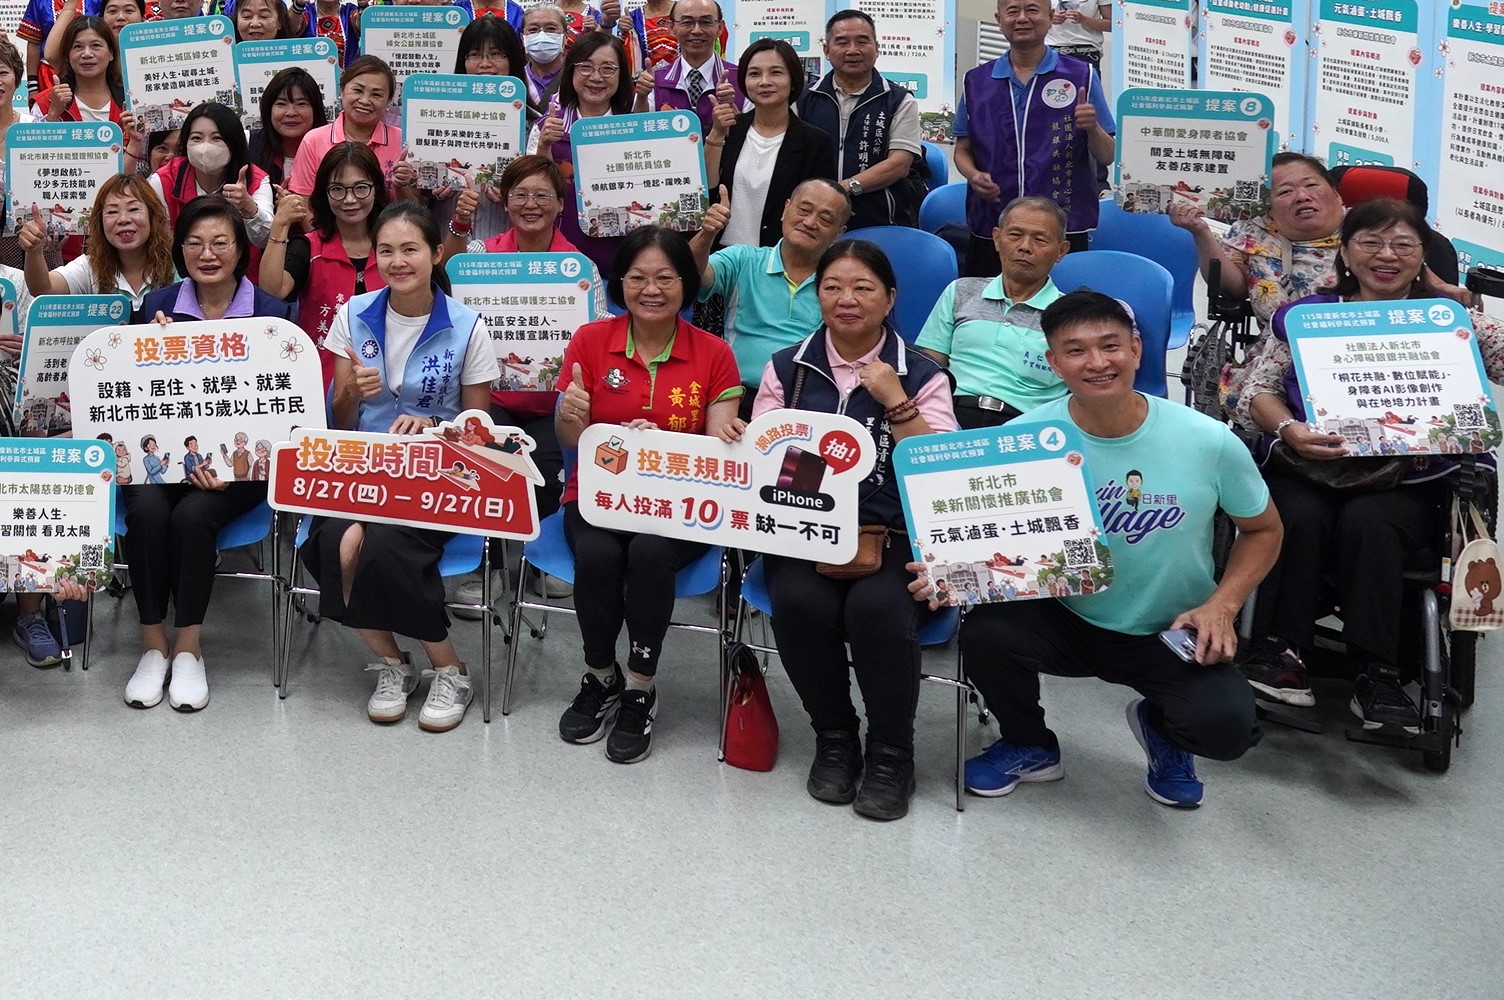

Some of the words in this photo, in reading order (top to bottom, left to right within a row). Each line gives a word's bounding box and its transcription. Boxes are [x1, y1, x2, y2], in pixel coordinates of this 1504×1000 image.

[183, 24, 206, 36] 提案
[140, 49, 218, 65] 新北市土城區婦女會
[472, 83, 496, 94] 提案
[501, 85, 513, 94] 25
[1205, 99, 1237, 112] 提案
[1246, 102, 1256, 111] 8
[643, 119, 670, 131] 提案
[71, 129, 95, 140] 提案
[99, 130, 111, 138] 10
[1141, 127, 1248, 141] 中華關愛身障者協會
[624, 150, 652, 160] 新北市
[1151, 147, 1236, 161] 關愛土城無障礙
[1156, 161, 1228, 174] 友善店家建置
[34, 180, 96, 188] 兒少多元技能與
[43, 192, 87, 200] 職人探索營
[528, 261, 557, 274] 提案
[563, 263, 577, 272] 12
[464, 296, 576, 305] 新北市土城區導護志工協會
[87, 302, 108, 317] 提案
[110, 305, 122, 315] 22
[1387, 309, 1427, 325] 提案
[1432, 311, 1450, 320] 26
[134, 332, 250, 367] 投票資格
[1346, 341, 1421, 351] 社團法人新北市
[98, 372, 292, 400] 設籍、居住、就學、就業
[1348, 384, 1443, 396] 身障者AI影像創作
[89, 396, 305, 423] 新北市並年滿15歲以上市民
[1356, 397, 1440, 408] 與在地培力計畫
[755, 422, 812, 454] 網路投票
[997, 434, 1036, 453] 提案
[1046, 432, 1058, 446] 4
[52, 448, 81, 463] 提案
[89, 449, 100, 463] 3
[822, 438, 856, 462] 抽!
[296, 436, 444, 481] 投票時間
[636, 448, 753, 490] 投票規則
[968, 473, 1017, 492] 新北市
[293, 478, 387, 506] 8/27(四)
[420, 491, 514, 522] 9/27(日)
[773, 489, 823, 508] iPhone
[932, 486, 1063, 514] 樂新關懷推廣協會
[1143, 494, 1177, 505] 日新里
[13, 508, 67, 520] 樂善人生-
[595, 490, 672, 519] 每人投滿
[681, 496, 723, 529] 10
[731, 510, 750, 531] 票
[756, 514, 841, 545] 缺一不可
[42, 525, 90, 537] 看見太陽
